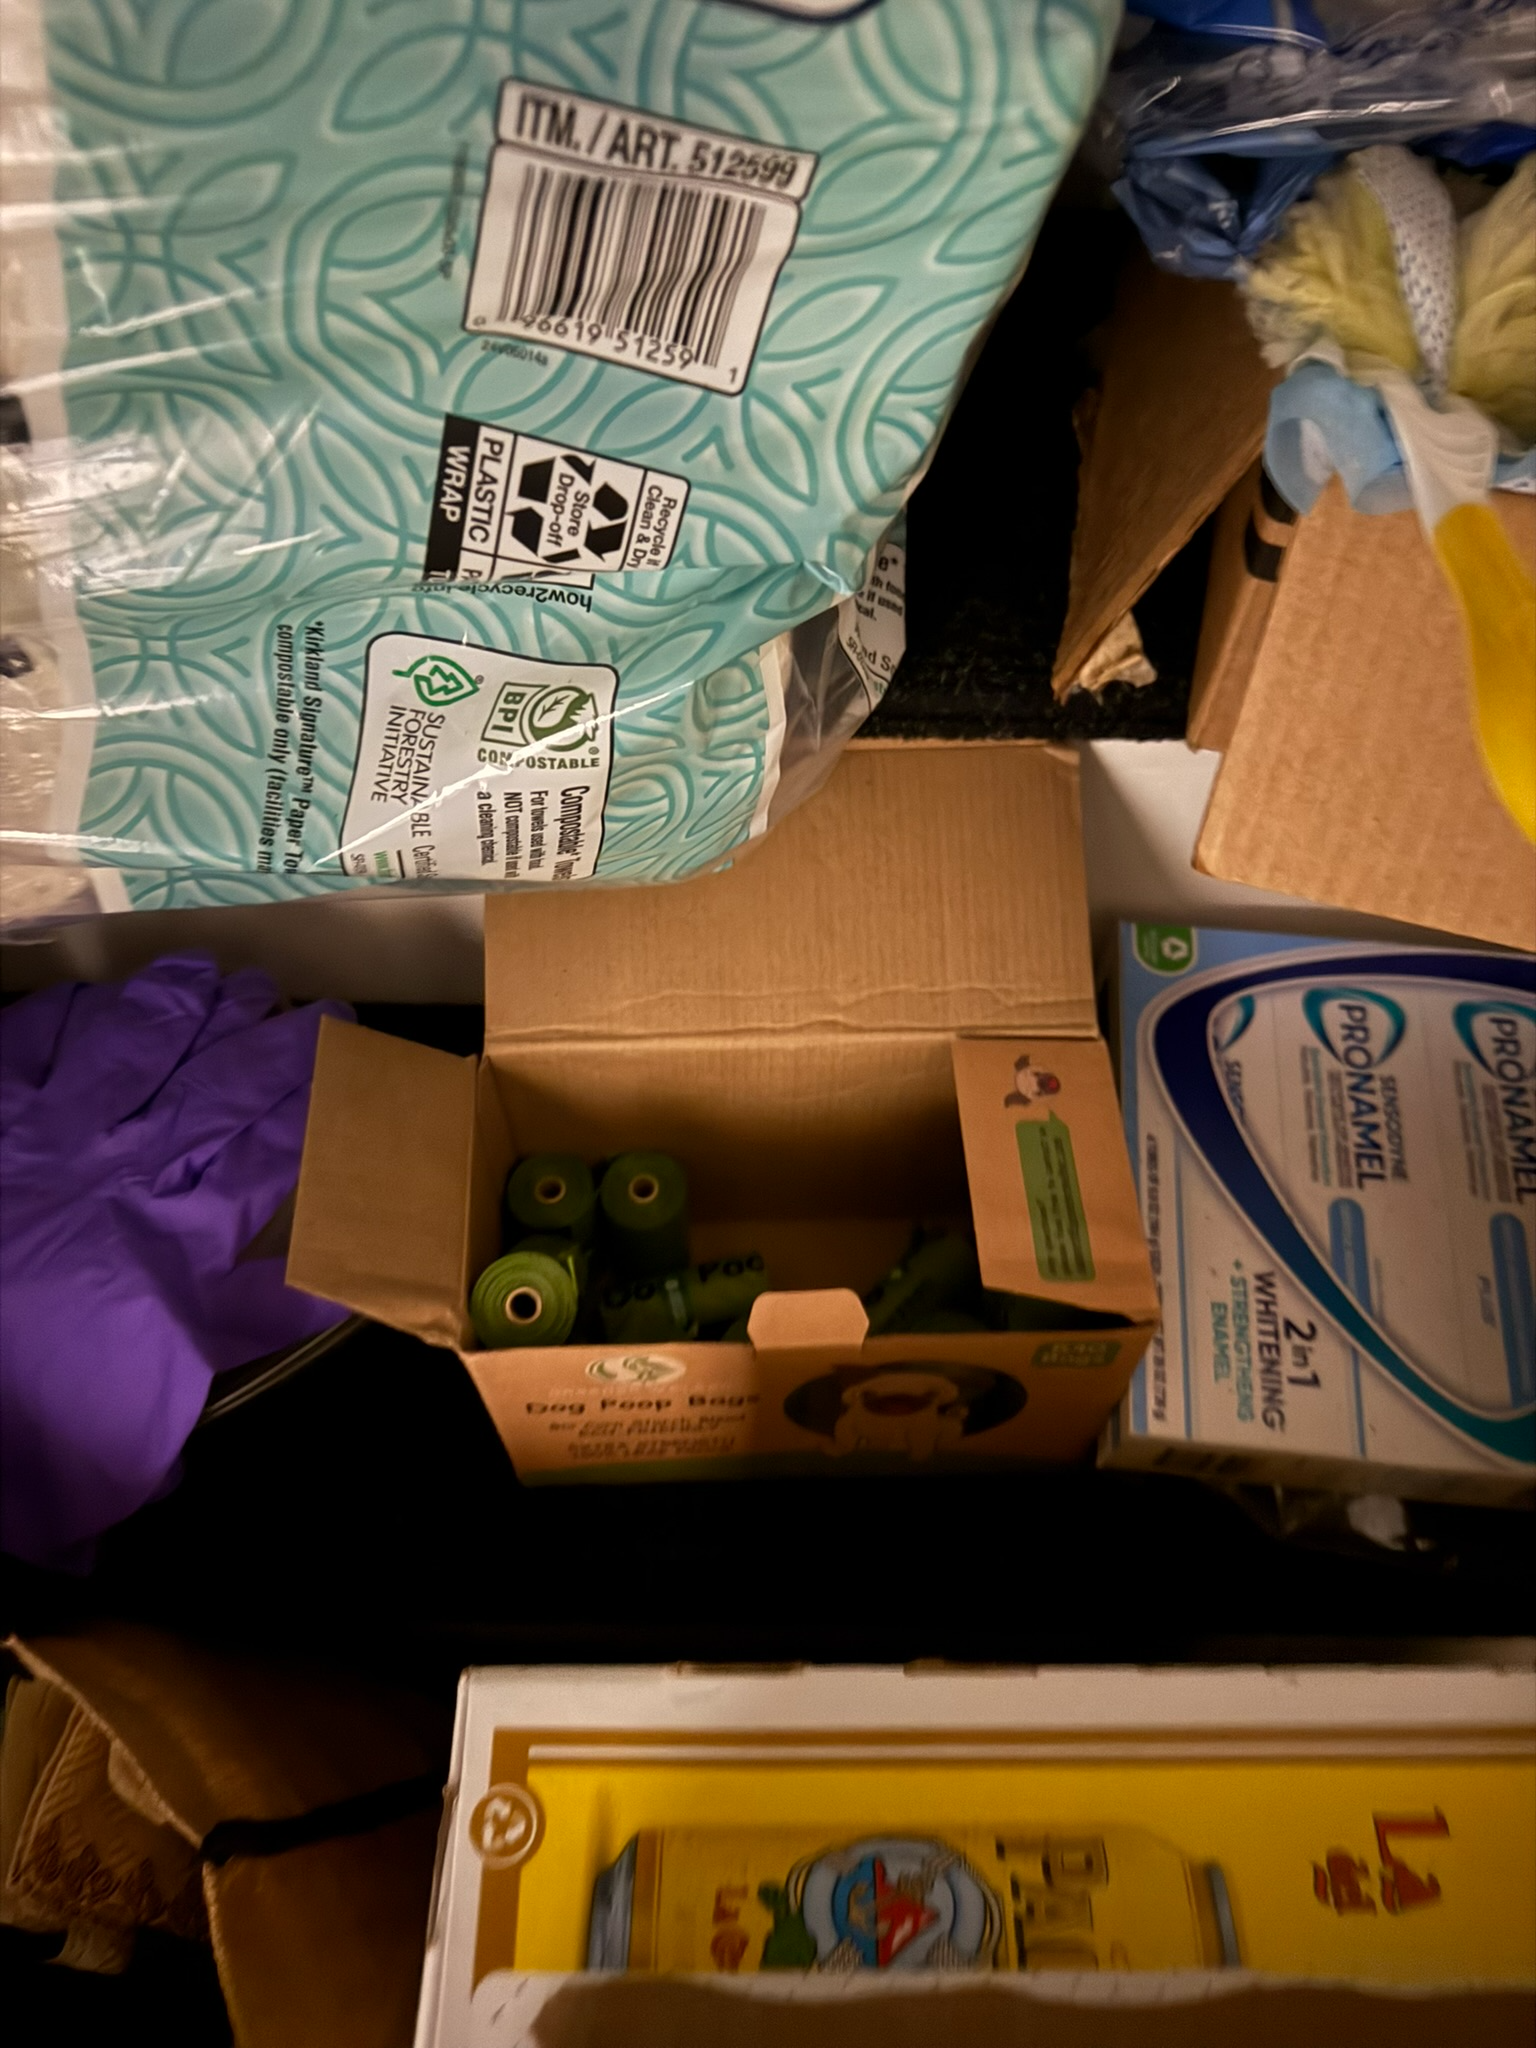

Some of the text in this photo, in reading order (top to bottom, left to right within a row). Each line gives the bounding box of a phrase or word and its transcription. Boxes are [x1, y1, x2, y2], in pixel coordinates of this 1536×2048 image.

[515, 92, 582, 150] ITM.
[606, 120, 682, 172] ART.
[687, 142, 799, 188] 512599
[614, 330, 695, 371] 51259
[729, 366, 738, 384] 1
[439, 444, 471, 523] WRAP
[468, 436, 505, 544] PLASTIC
[546, 472, 575, 548] Drop-off
[566, 490, 590, 537] Store
[627, 484, 662, 569] Clean & Dry
[651, 496, 678, 555] Recycle
[272, 623, 296, 725] compostable
[490, 690, 528, 734] BPI
[266, 726, 292, 764] only
[370, 704, 407, 803] INITIATIVE
[390, 708, 427, 806] FORESTRY
[285, 794, 311, 844] Paper
[476, 791, 493, 800] a
[476, 802, 498, 839] cleaning
[503, 792, 523, 813] NOT
[529, 790, 549, 806] For
[530, 806, 549, 832] towels
[1337, 1001, 1386, 1191] PRONAMEL
[1210, 1300, 1231, 1384] ENAMEL
[1253, 1269, 1287, 1433] WHITENING
[525, 1401, 586, 1416] Dog
[600, 1397, 673, 1413] Poop
